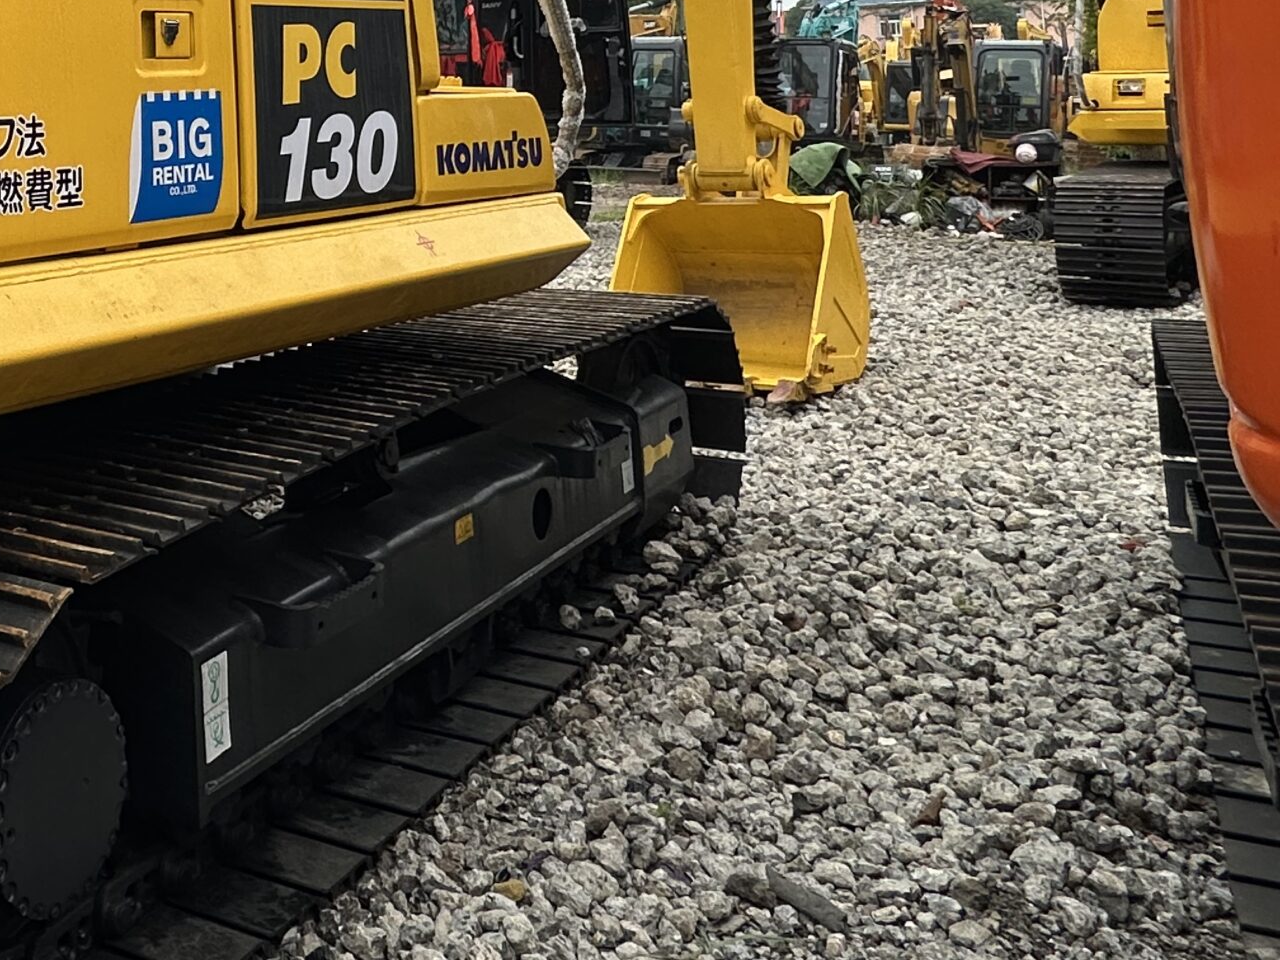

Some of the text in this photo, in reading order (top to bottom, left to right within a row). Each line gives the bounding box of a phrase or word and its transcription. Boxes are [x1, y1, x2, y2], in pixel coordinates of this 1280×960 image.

[282, 21, 357, 105] PC
[151, 117, 213, 160] BIG
[280, 110, 398, 202] 130
[436, 130, 542, 176] KOMATSU
[152, 162, 214, 187] RENTAL
